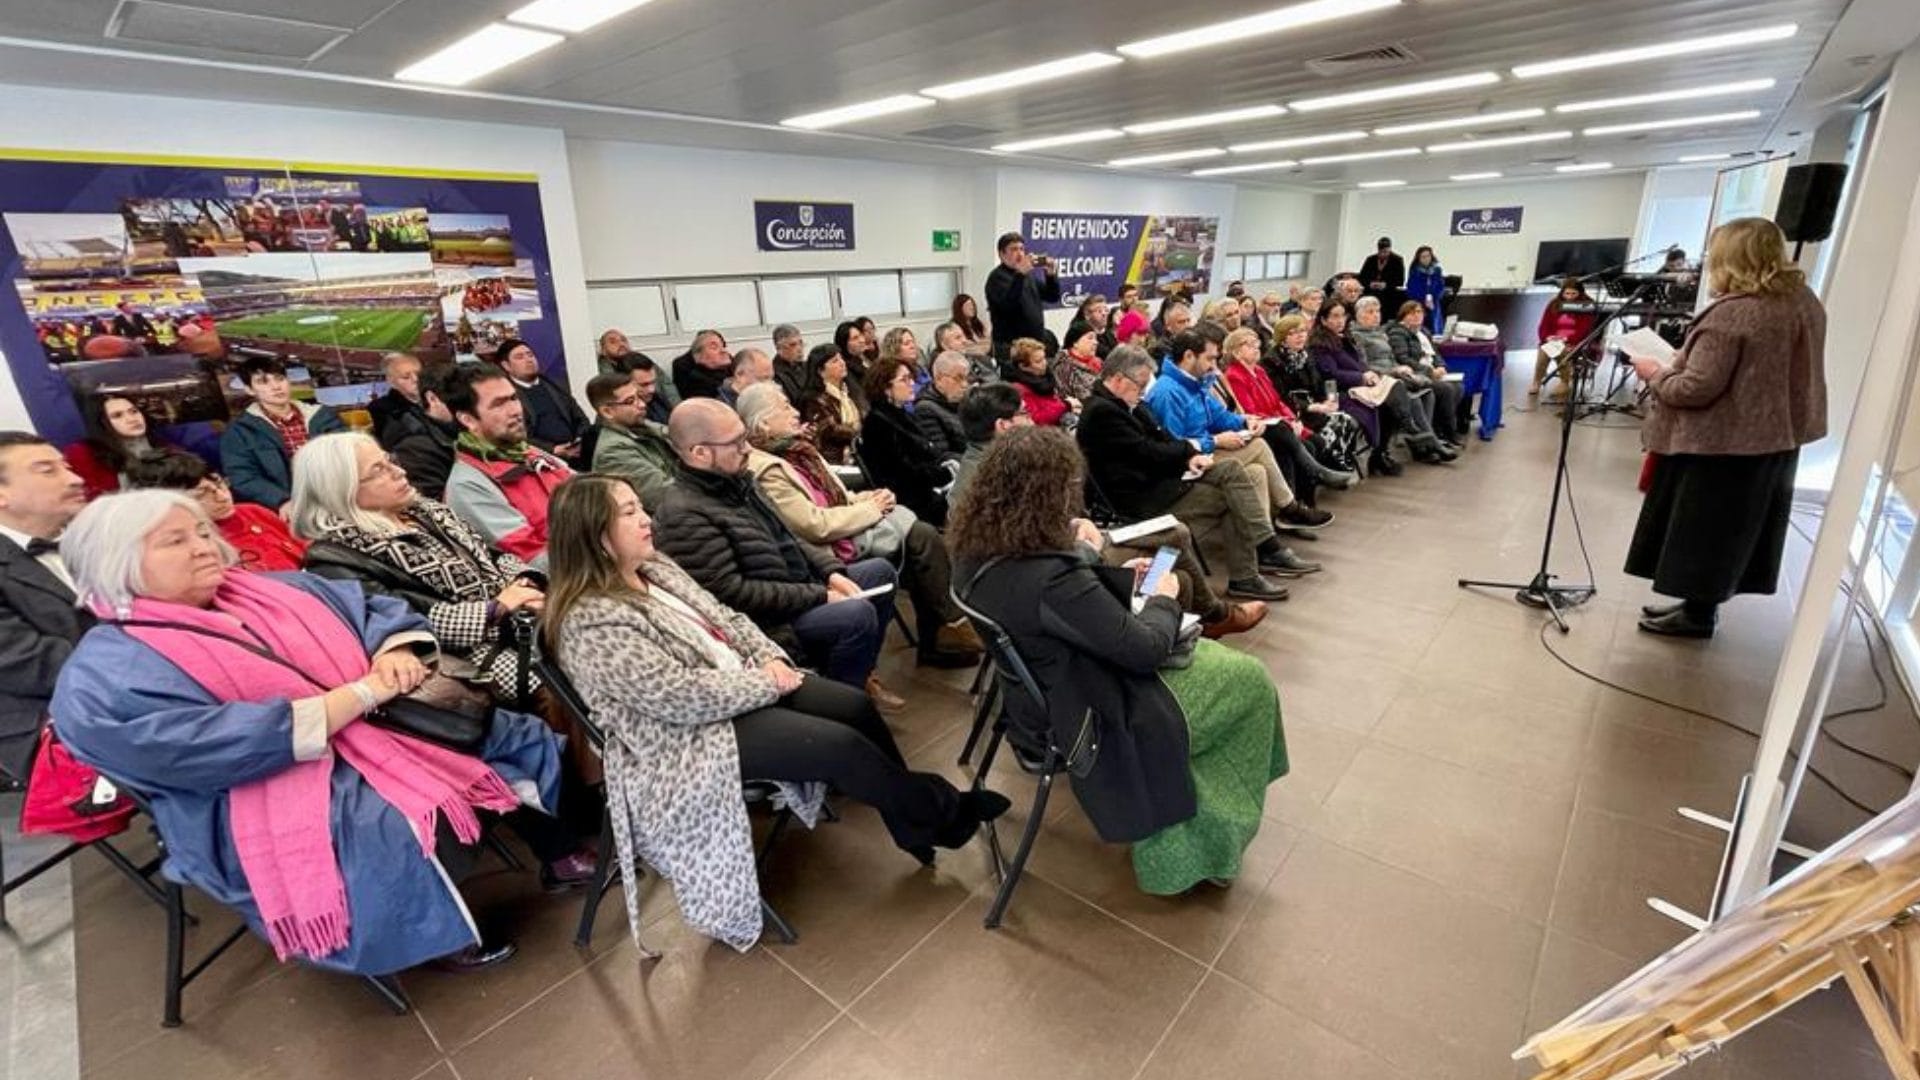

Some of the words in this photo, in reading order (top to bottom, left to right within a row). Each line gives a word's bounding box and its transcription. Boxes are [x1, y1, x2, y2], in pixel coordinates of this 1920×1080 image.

[766, 219, 846, 249] Concepción
[1031, 218, 1129, 240] BIENVENIDOS
[1053, 256, 1114, 278] ELCOME
